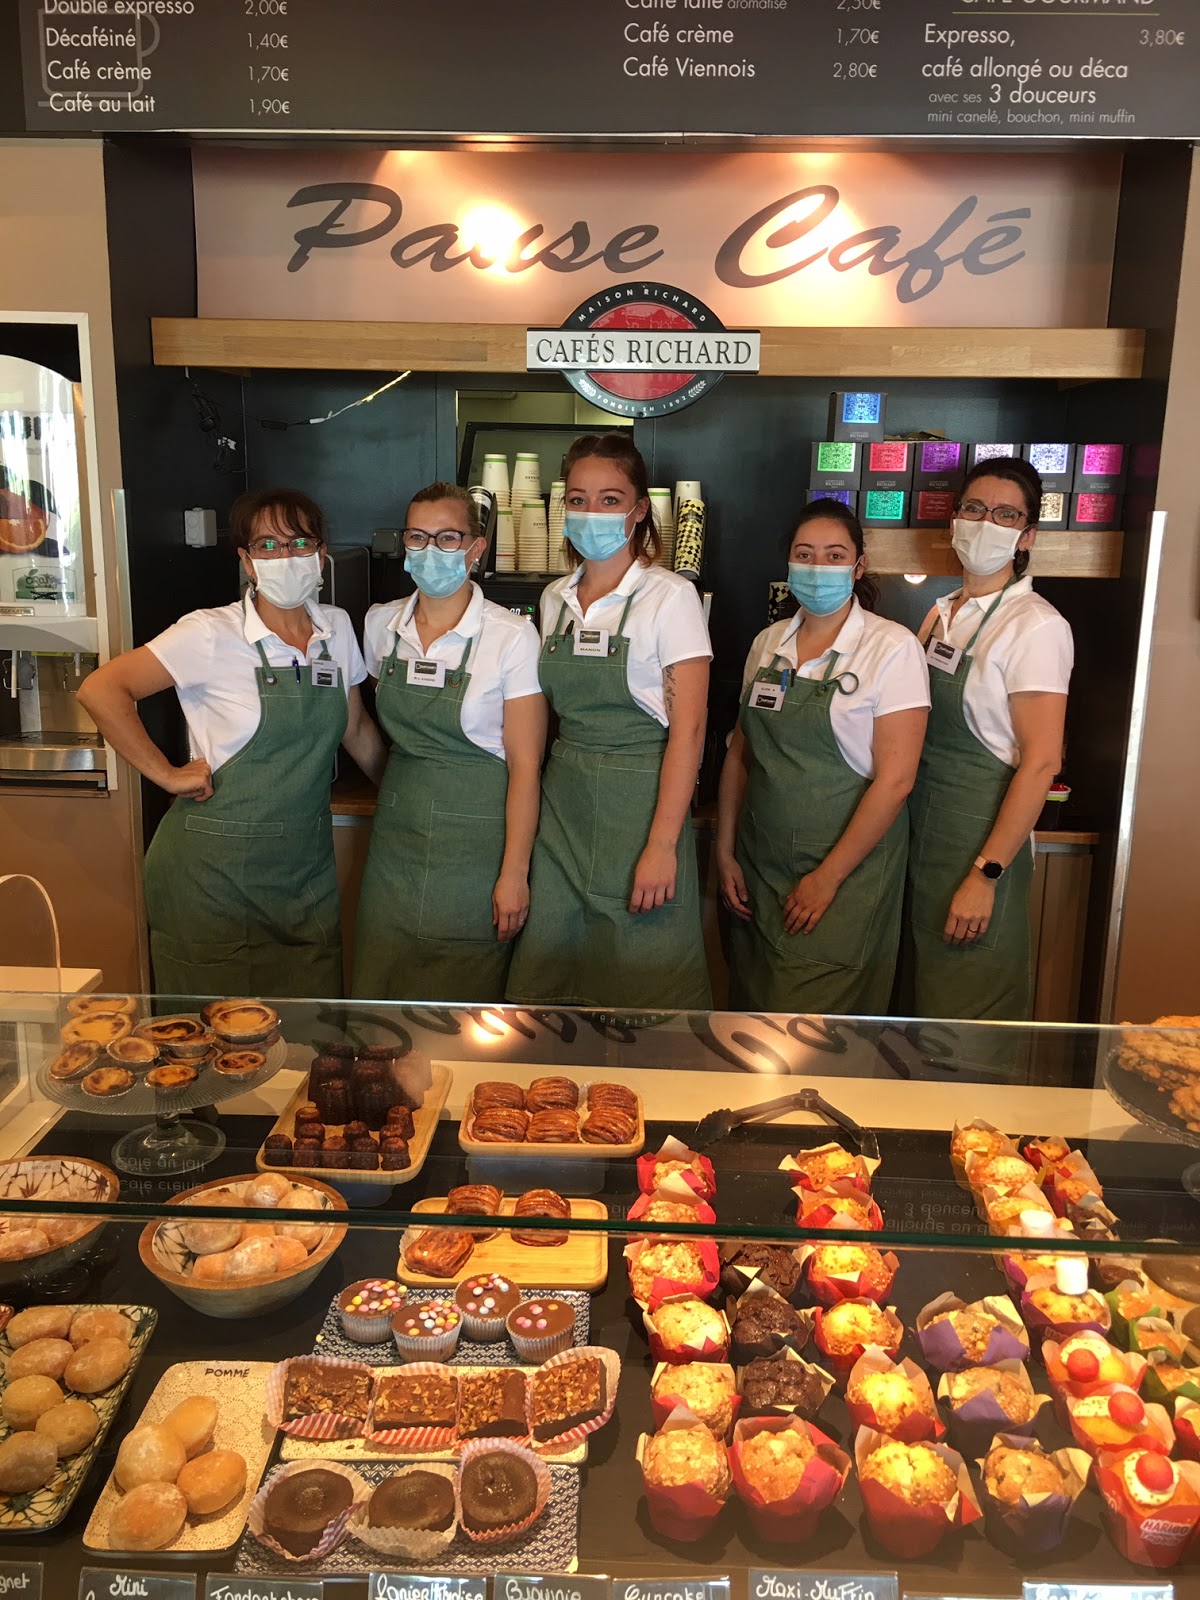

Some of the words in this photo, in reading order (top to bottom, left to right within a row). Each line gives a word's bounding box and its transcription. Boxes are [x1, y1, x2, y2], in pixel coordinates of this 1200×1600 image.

[44, 0, 107, 14] Double
[114, 0, 195, 19] expresso
[244, 0, 288, 17] 2,00€
[45, 27, 137, 48] Décaféiné
[247, 32, 289, 50] 1,40€
[624, 21, 670, 44] Café
[676, 23, 735, 44] crème
[836, 28, 880, 46] 1,70€
[924, 23, 1016, 49] Expresso,
[1139, 29, 1186, 47] 3,80€
[47, 60, 91, 80] Café
[96, 63, 152, 80] crème
[248, 65, 290, 82] 1,70€
[622, 55, 669, 77] Café
[675, 57, 756, 77] Viennois
[832, 62, 878, 80] 2,80€
[921, 55, 964, 77] café
[969, 55, 1043, 84] allongé
[1048, 63, 1074, 78] ou
[1079, 56, 1129, 79] déca
[49, 93, 93, 112] Café
[98, 98, 122, 112] au
[127, 91, 156, 113] lait
[928, 91, 959, 104] avec
[962, 92, 983, 104] ses
[988, 83, 1002, 104] 3
[1009, 81, 1097, 104] douceurs
[249, 98, 291, 115] 1,90€
[927, 109, 953, 123] mini
[956, 108, 1001, 125] canelé,
[1006, 109, 1064, 125] bouchon,
[1069, 109, 1096, 124] mini
[1098, 108, 1136, 124] muffin
[286, 182, 667, 273] Pause
[714, 184, 1032, 304] Café
[578, 289, 634, 323] MAISON
[643, 288, 707, 322] RICHARD
[535, 333, 616, 364] CAFÉS
[626, 339, 752, 365] RICHARD
[205, 1368, 250, 1377] POMME
[109, 1574, 148, 1597] Mini
